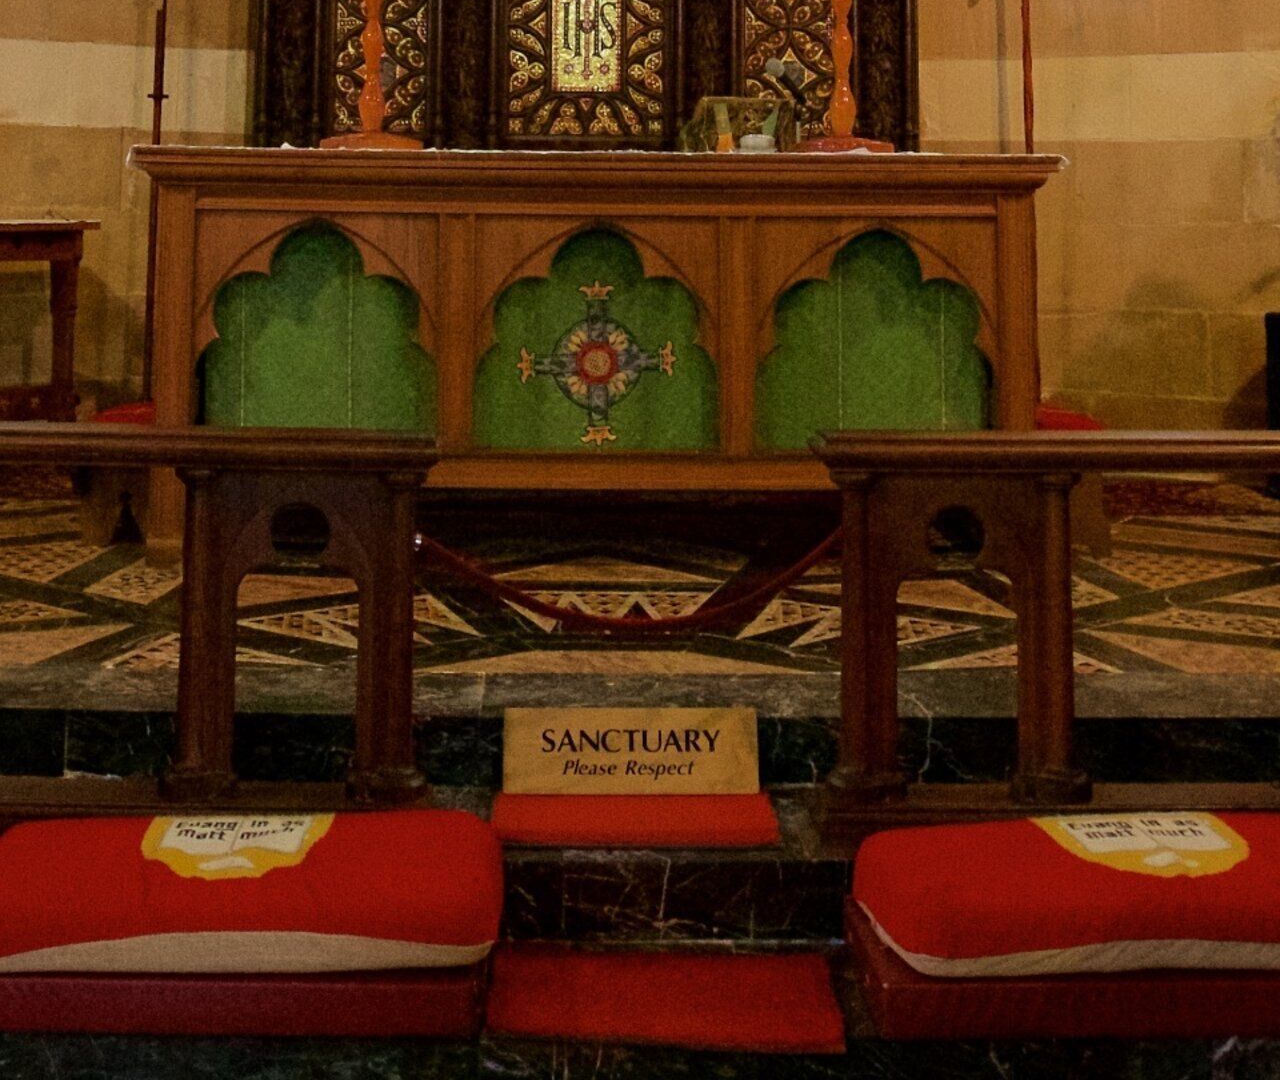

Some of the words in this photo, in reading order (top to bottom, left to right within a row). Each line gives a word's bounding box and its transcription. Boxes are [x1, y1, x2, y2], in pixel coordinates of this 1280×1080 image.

[541, 728, 720, 753] SANCTUARY
[562, 758, 618, 776] Please
[624, 758, 695, 781] Respect
